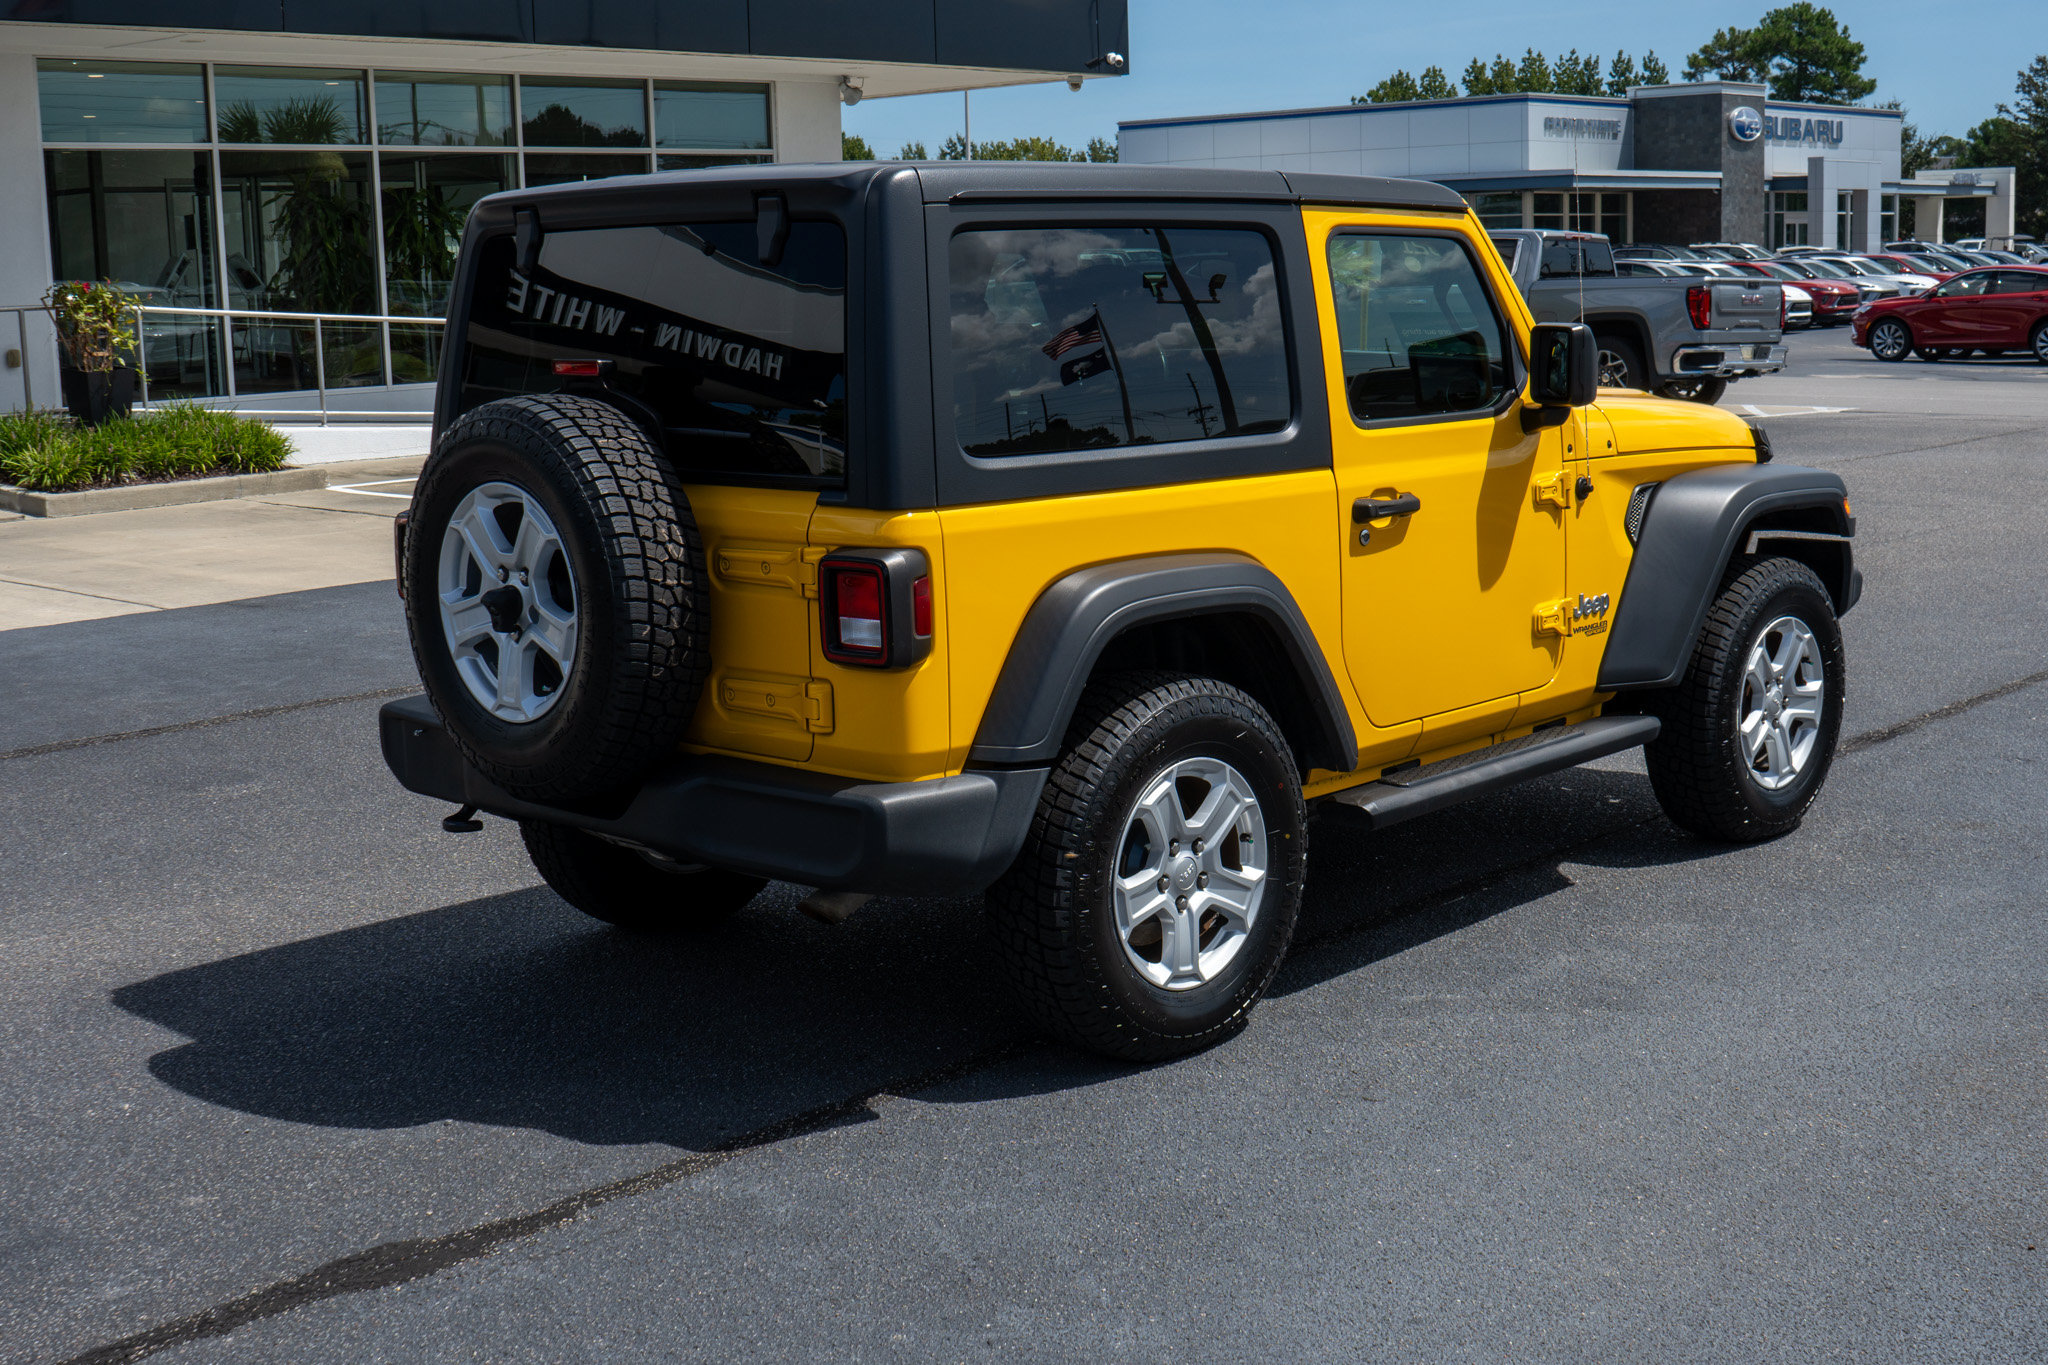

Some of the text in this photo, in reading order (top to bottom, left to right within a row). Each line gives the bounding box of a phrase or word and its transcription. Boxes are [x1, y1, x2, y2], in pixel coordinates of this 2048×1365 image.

[1764, 116, 1843, 144] SUBARU
[1573, 592, 1609, 618] Jeep
[1573, 620, 1608, 634] WRANGLER
